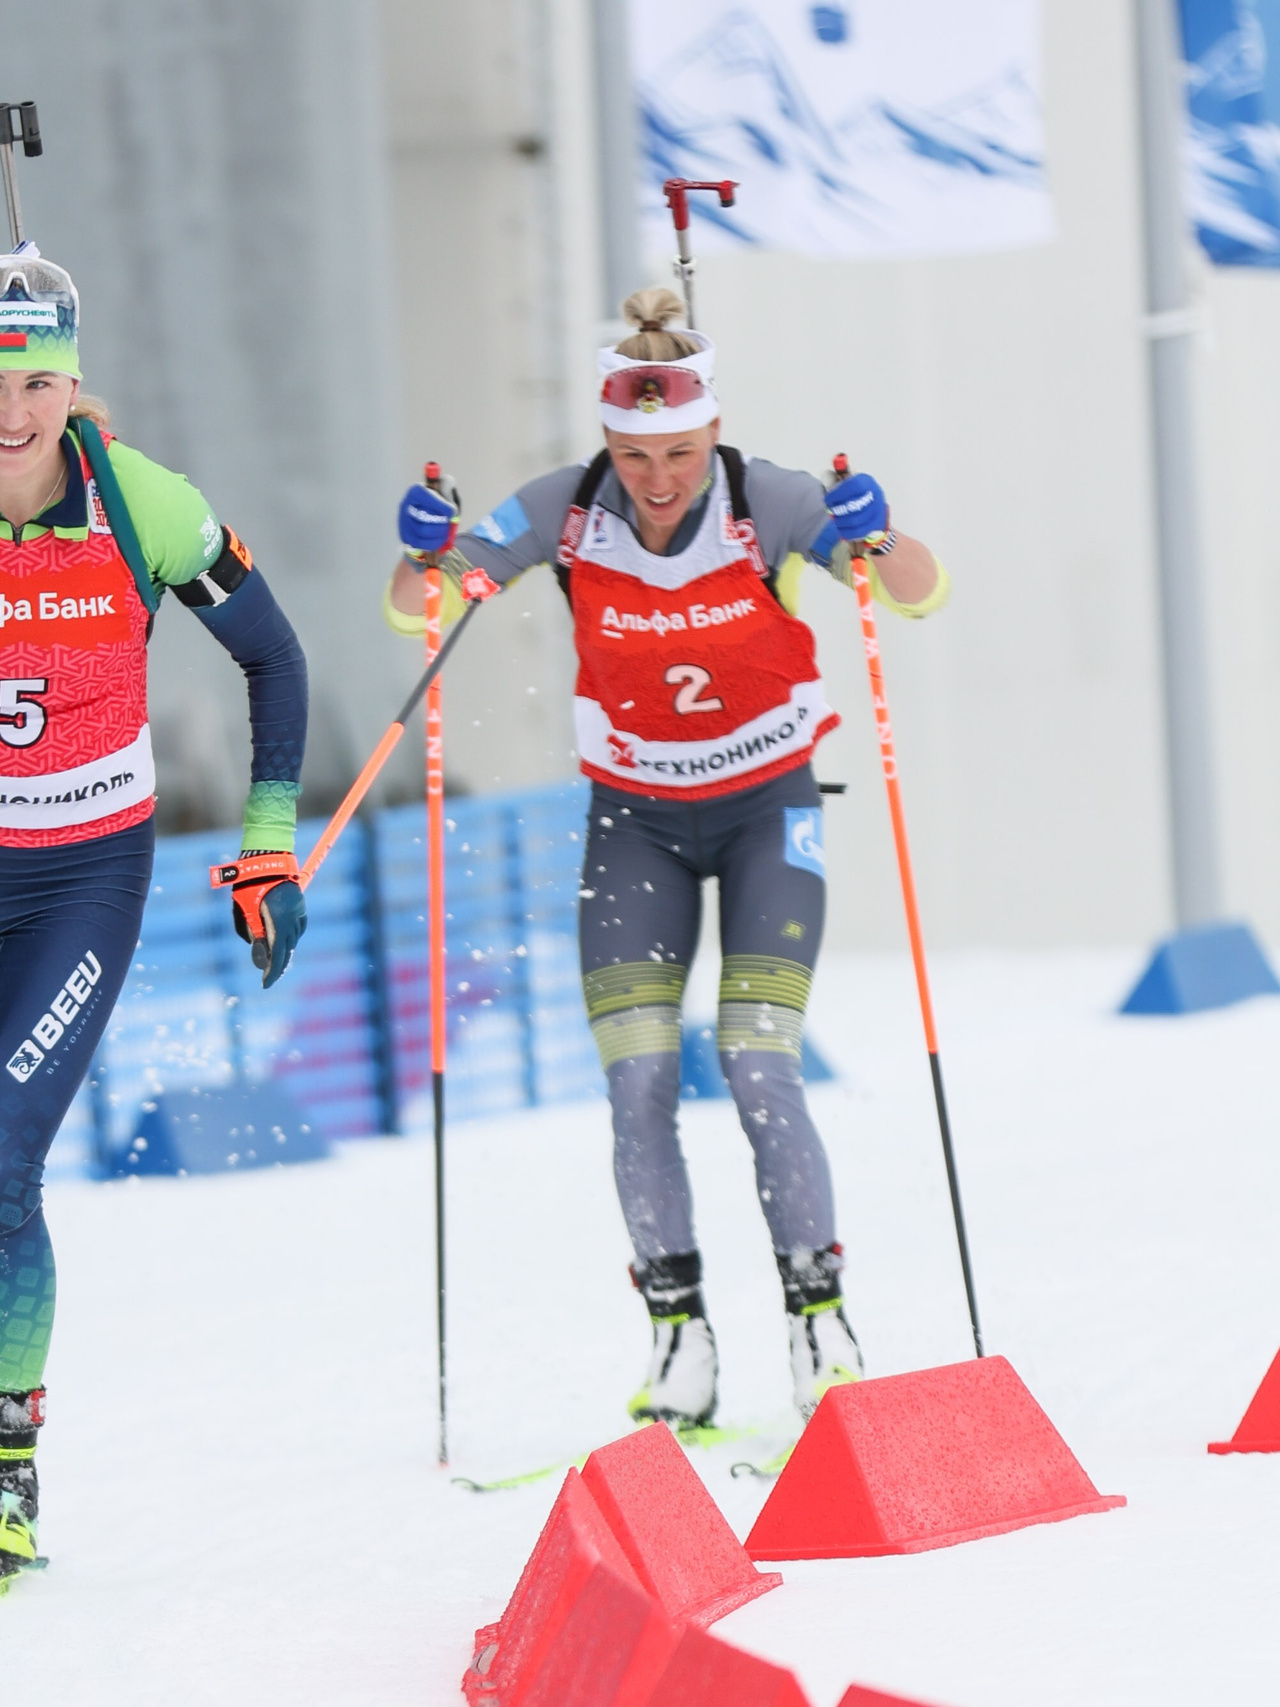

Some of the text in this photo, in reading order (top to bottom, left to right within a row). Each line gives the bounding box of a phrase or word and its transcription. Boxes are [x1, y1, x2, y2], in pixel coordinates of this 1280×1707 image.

[39, 592, 116, 620] Банк
[601, 598, 757, 637] Альфа Банк
[664, 663, 725, 715] 2
[32, 949, 102, 1050] BEEU
[46, 1059, 61, 1075] BE
